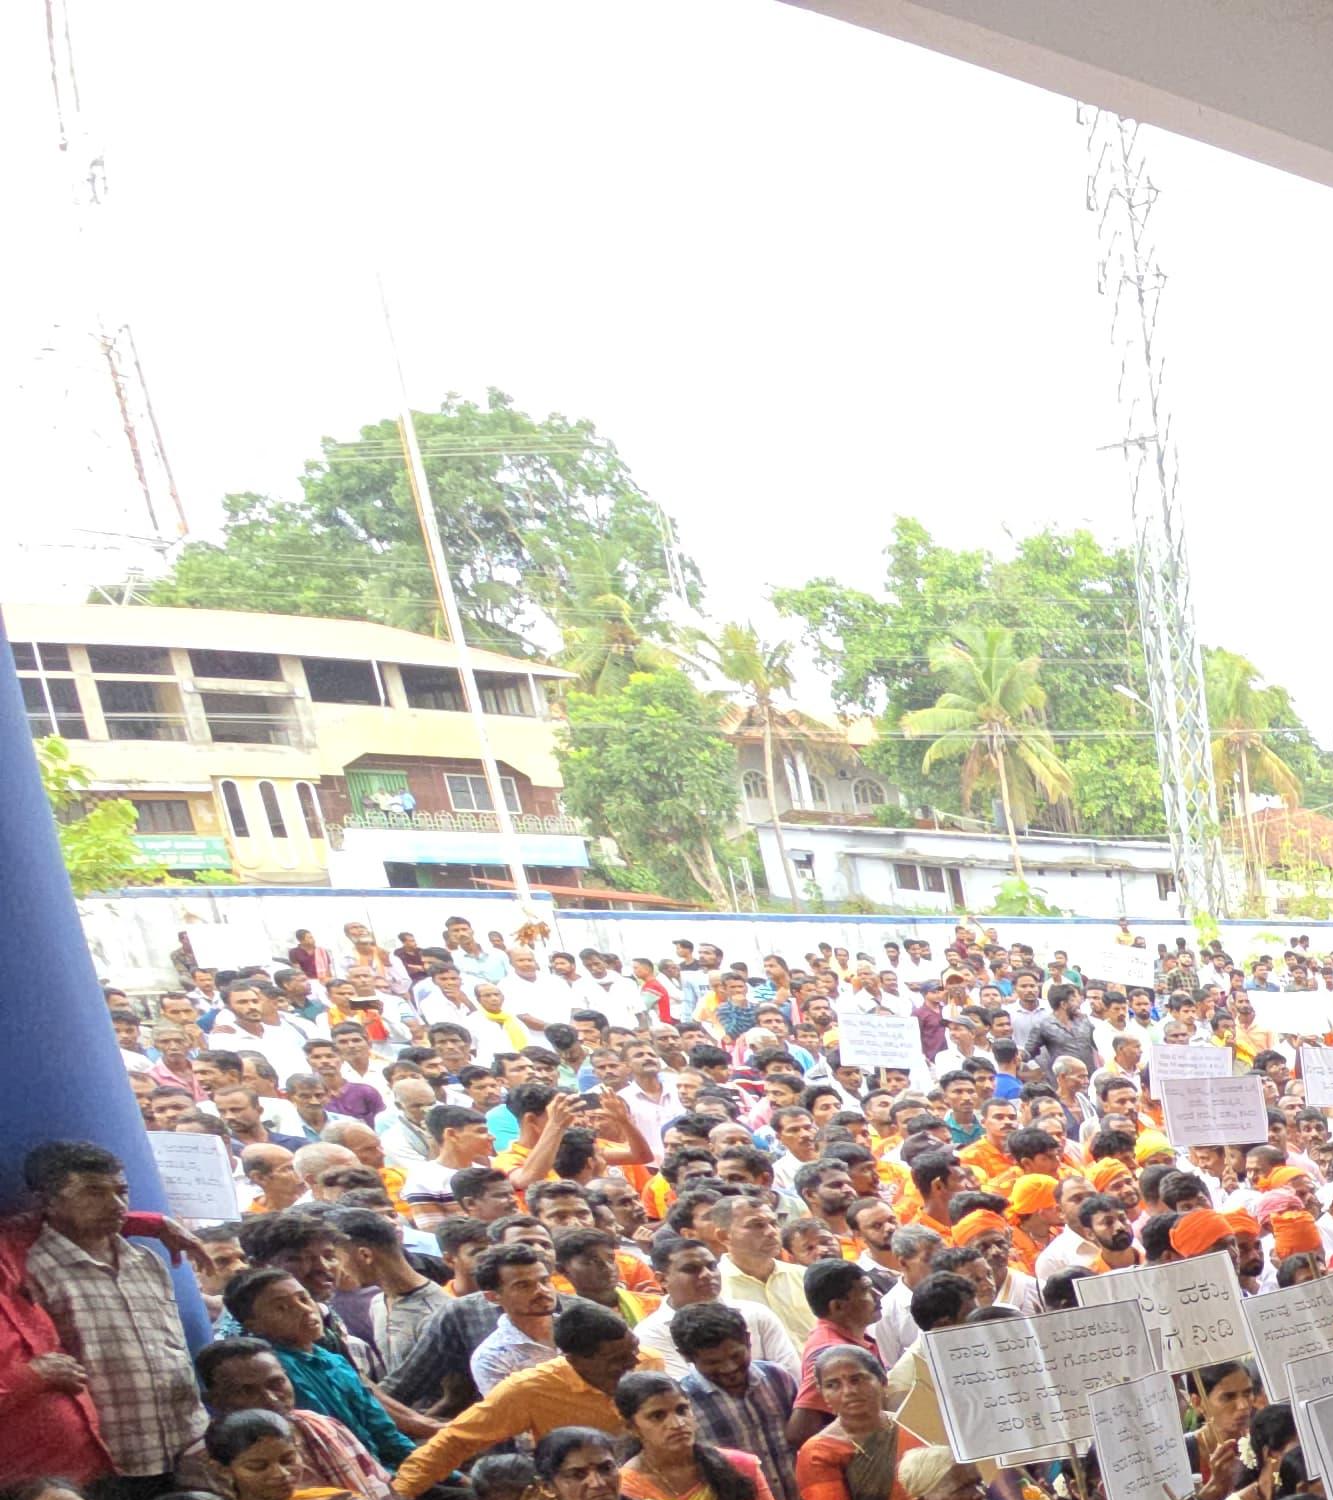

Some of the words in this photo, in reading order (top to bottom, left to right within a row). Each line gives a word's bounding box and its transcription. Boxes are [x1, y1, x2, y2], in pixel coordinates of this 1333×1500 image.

[1177, 1280, 1230, 1306] ಹಕ್ಕು
[1192, 1318, 1235, 1345] ನೀಡಿ
[949, 1343, 991, 1362] ನಾವು
[952, 1359, 1057, 1387] ಸಮುದಾಯದ
[983, 1391, 1031, 1409] ಎಂದು
[1035, 1383, 1078, 1400] ನಮ್ಮ
[996, 1411, 1045, 1433] ಪರೀಕ್ಷೆ
